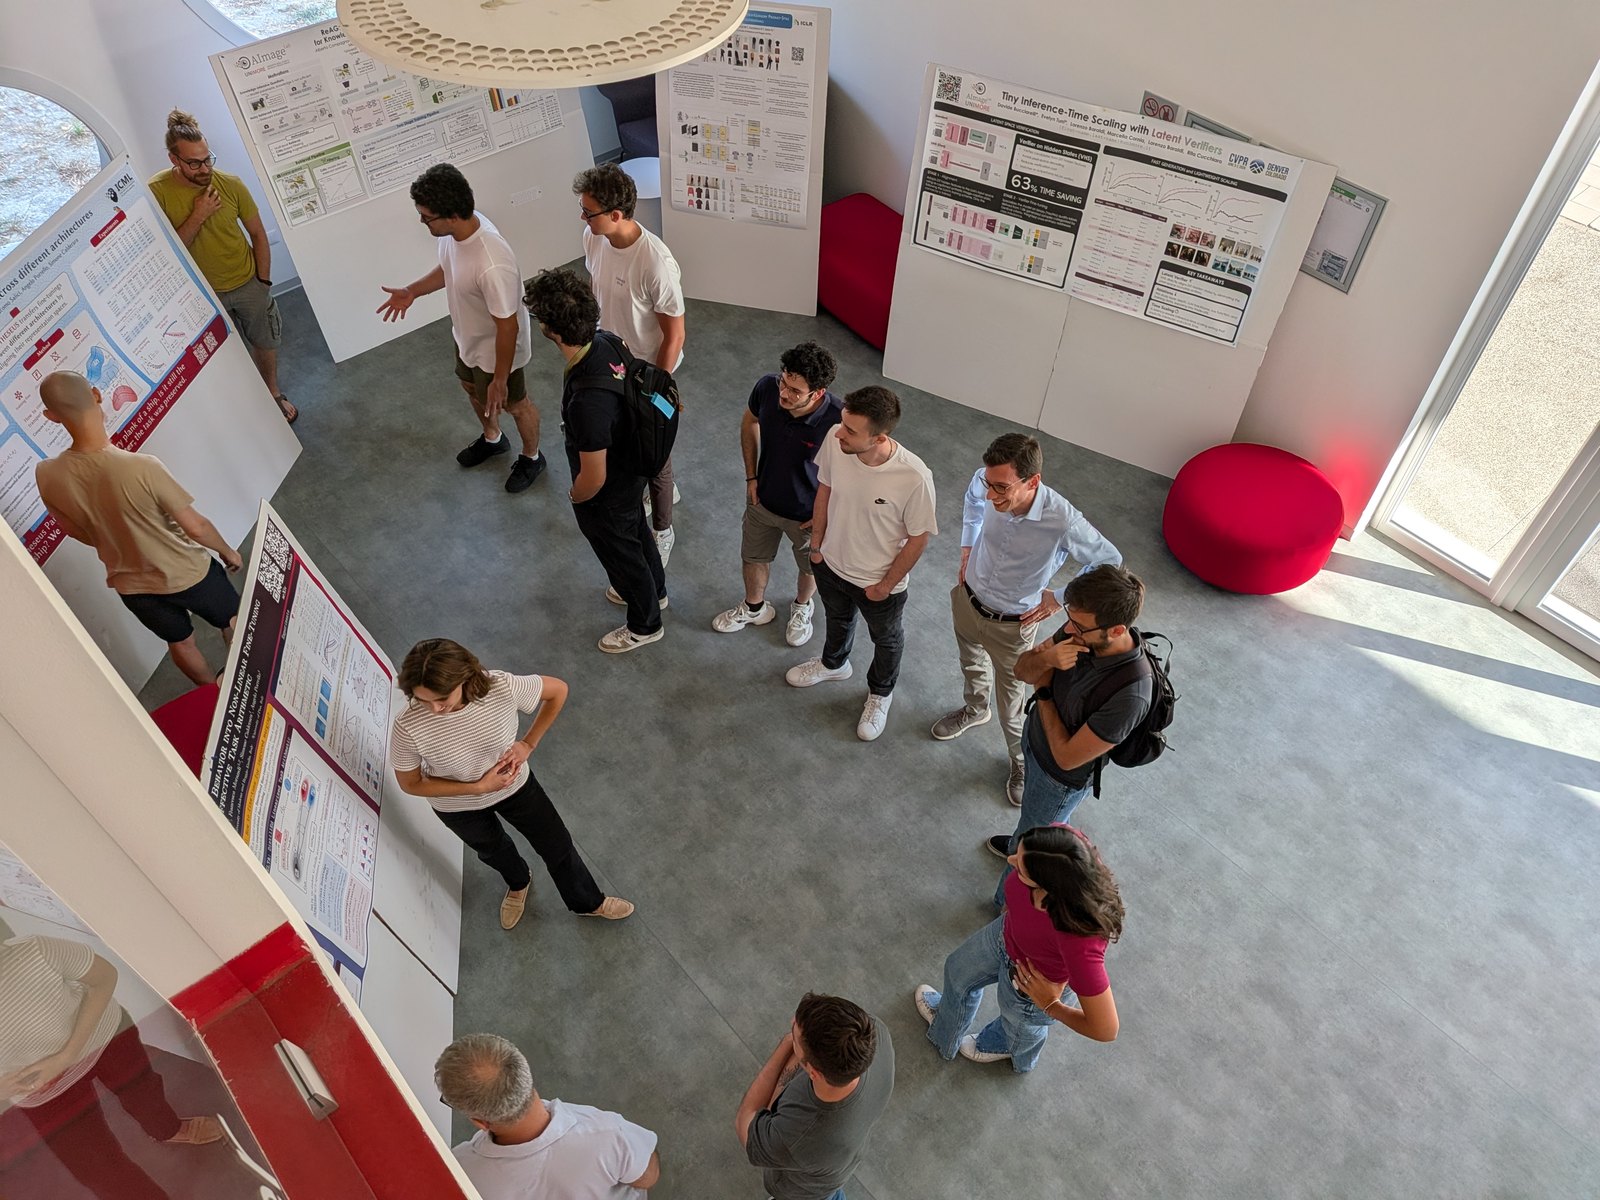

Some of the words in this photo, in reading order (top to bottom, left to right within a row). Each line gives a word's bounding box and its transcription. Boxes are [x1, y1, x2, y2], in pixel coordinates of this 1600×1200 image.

[313, 37, 322, 46] for
[250, 46, 286, 66] AImage
[997, 102, 1012, 110] Davide
[1040, 113, 1055, 122] Evelyn
[1069, 121, 1088, 130] Lorenzo
[1106, 130, 1128, 139] Marcella
[1147, 140, 1166, 148] Lorenzo
[1001, 91, 1019, 104] Tiny
[1019, 96, 1090, 123] Inference-Time
[1090, 114, 1127, 133] Scaling
[1129, 122, 1150, 136] with
[1150, 128, 1182, 145] Latent
[1182, 136, 1224, 156] Verifiers
[1015, 124, 1040, 134] VERIFICATION
[1018, 138, 1036, 147] Verifier
[1043, 144, 1062, 154] Hidden
[1061, 149, 1078, 158] States
[1228, 152, 1249, 166] CVPR
[1266, 162, 1289, 175] DENVER
[114, 171, 133, 191] ICML
[1160, 161, 1186, 171] GENERATION
[1193, 170, 1220, 181] LIGHTWEIGHT
[1220, 177, 1238, 186] SCALING
[1265, 170, 1287, 180] COLORADO
[1038, 185, 1055, 197] TIME
[1055, 191, 1082, 204] SAVING
[97, 218, 119, 240] Experiments
[0, 275, 19, 297] cross
[17, 247, 51, 280] different
[49, 208, 94, 252] architectures
[19, 276, 35, 293] Angelo
[47, 252, 62, 267] Simone
[60, 237, 79, 256] Calderara
[1186, 269, 1196, 277] KEY
[1195, 272, 1225, 285] TAKEAWAYS
[18, 303, 38, 324] transfers
[36, 282, 62, 307] fine-tunings
[8, 324, 30, 346] different
[27, 297, 58, 327] architectures
[56, 292, 64, 301] by
[13, 340, 25, 353] their
[23, 312, 54, 343] representation
[35, 341, 51, 356] Method
[165, 371, 178, 386] still
[174, 362, 186, 375] the
[156, 388, 165, 398] is
[160, 383, 168, 392] it
[133, 427, 144, 441] the
[140, 413, 154, 430] task
[153, 403, 165, 417] was
[161, 375, 187, 406] preserved.
[145, 395, 160, 413] ship,
[134, 412, 145, 424] of
[120, 420, 138, 441] plank
[47, 526, 61, 542] We
[210, 744, 229, 797] BEHAVIOR
[222, 718, 233, 743] INTO
[230, 657, 247, 717] NON-LINEAR
[244, 598, 260, 656] FINE-TUNING
[228, 734, 239, 760] TASK
[235, 673, 252, 733] ARITHMETIC
